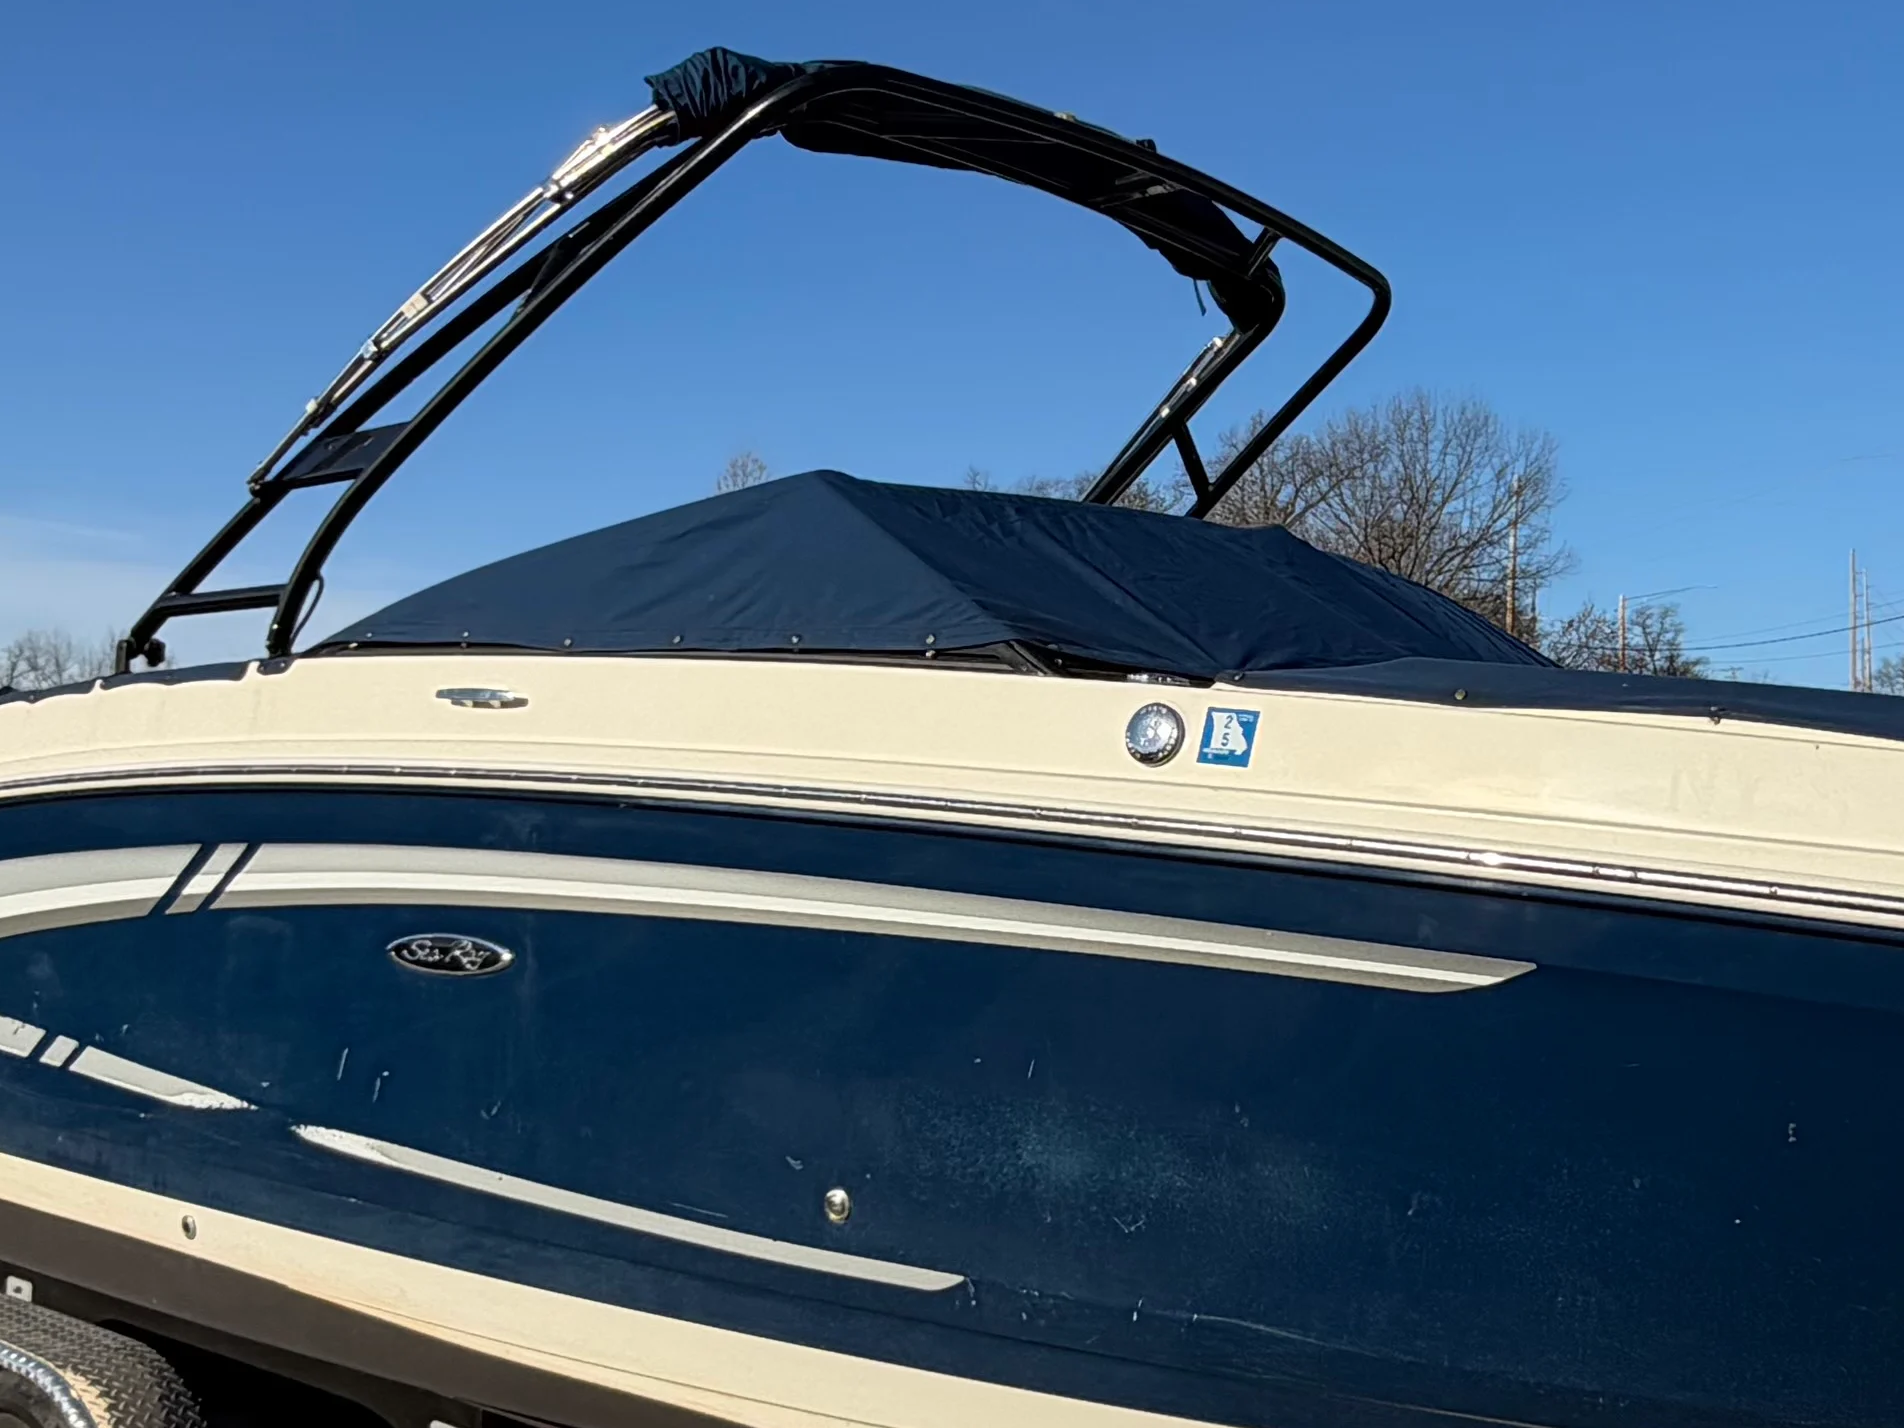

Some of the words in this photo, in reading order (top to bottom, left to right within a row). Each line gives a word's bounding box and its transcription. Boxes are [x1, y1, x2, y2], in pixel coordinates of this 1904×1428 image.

[1224, 714, 1234, 729] 2
[1220, 732, 1230, 747] 5
[401, 939, 444, 962] Sea
[445, 939, 491, 971] Ray
